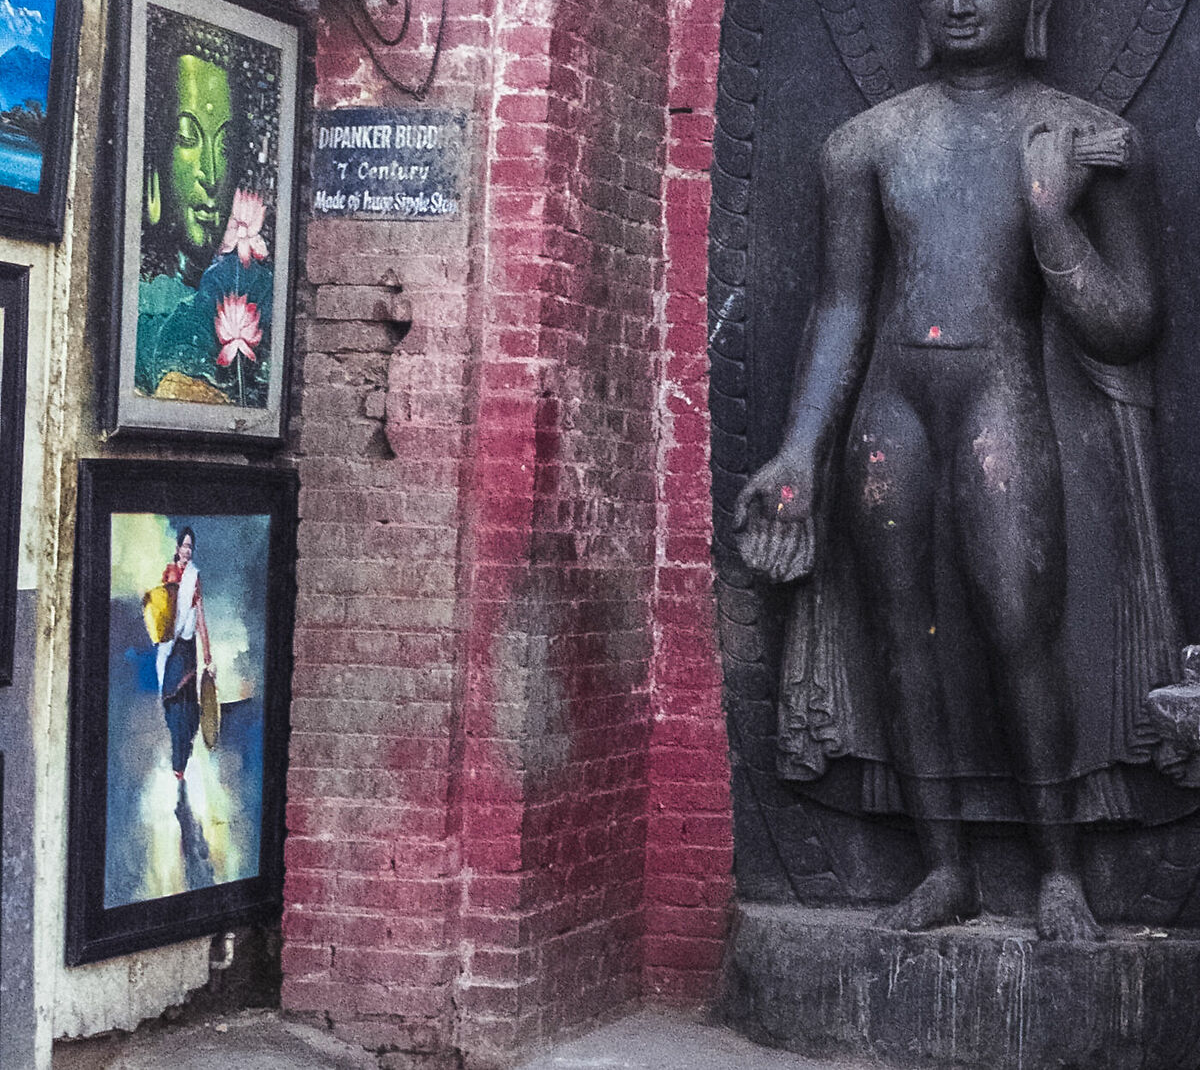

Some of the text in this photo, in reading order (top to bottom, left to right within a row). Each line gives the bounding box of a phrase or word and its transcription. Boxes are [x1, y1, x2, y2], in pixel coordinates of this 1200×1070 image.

[318, 125, 443, 149] DIPANKER BUDD
[358, 161, 430, 183] Century
[314, 190, 346, 213] Made
